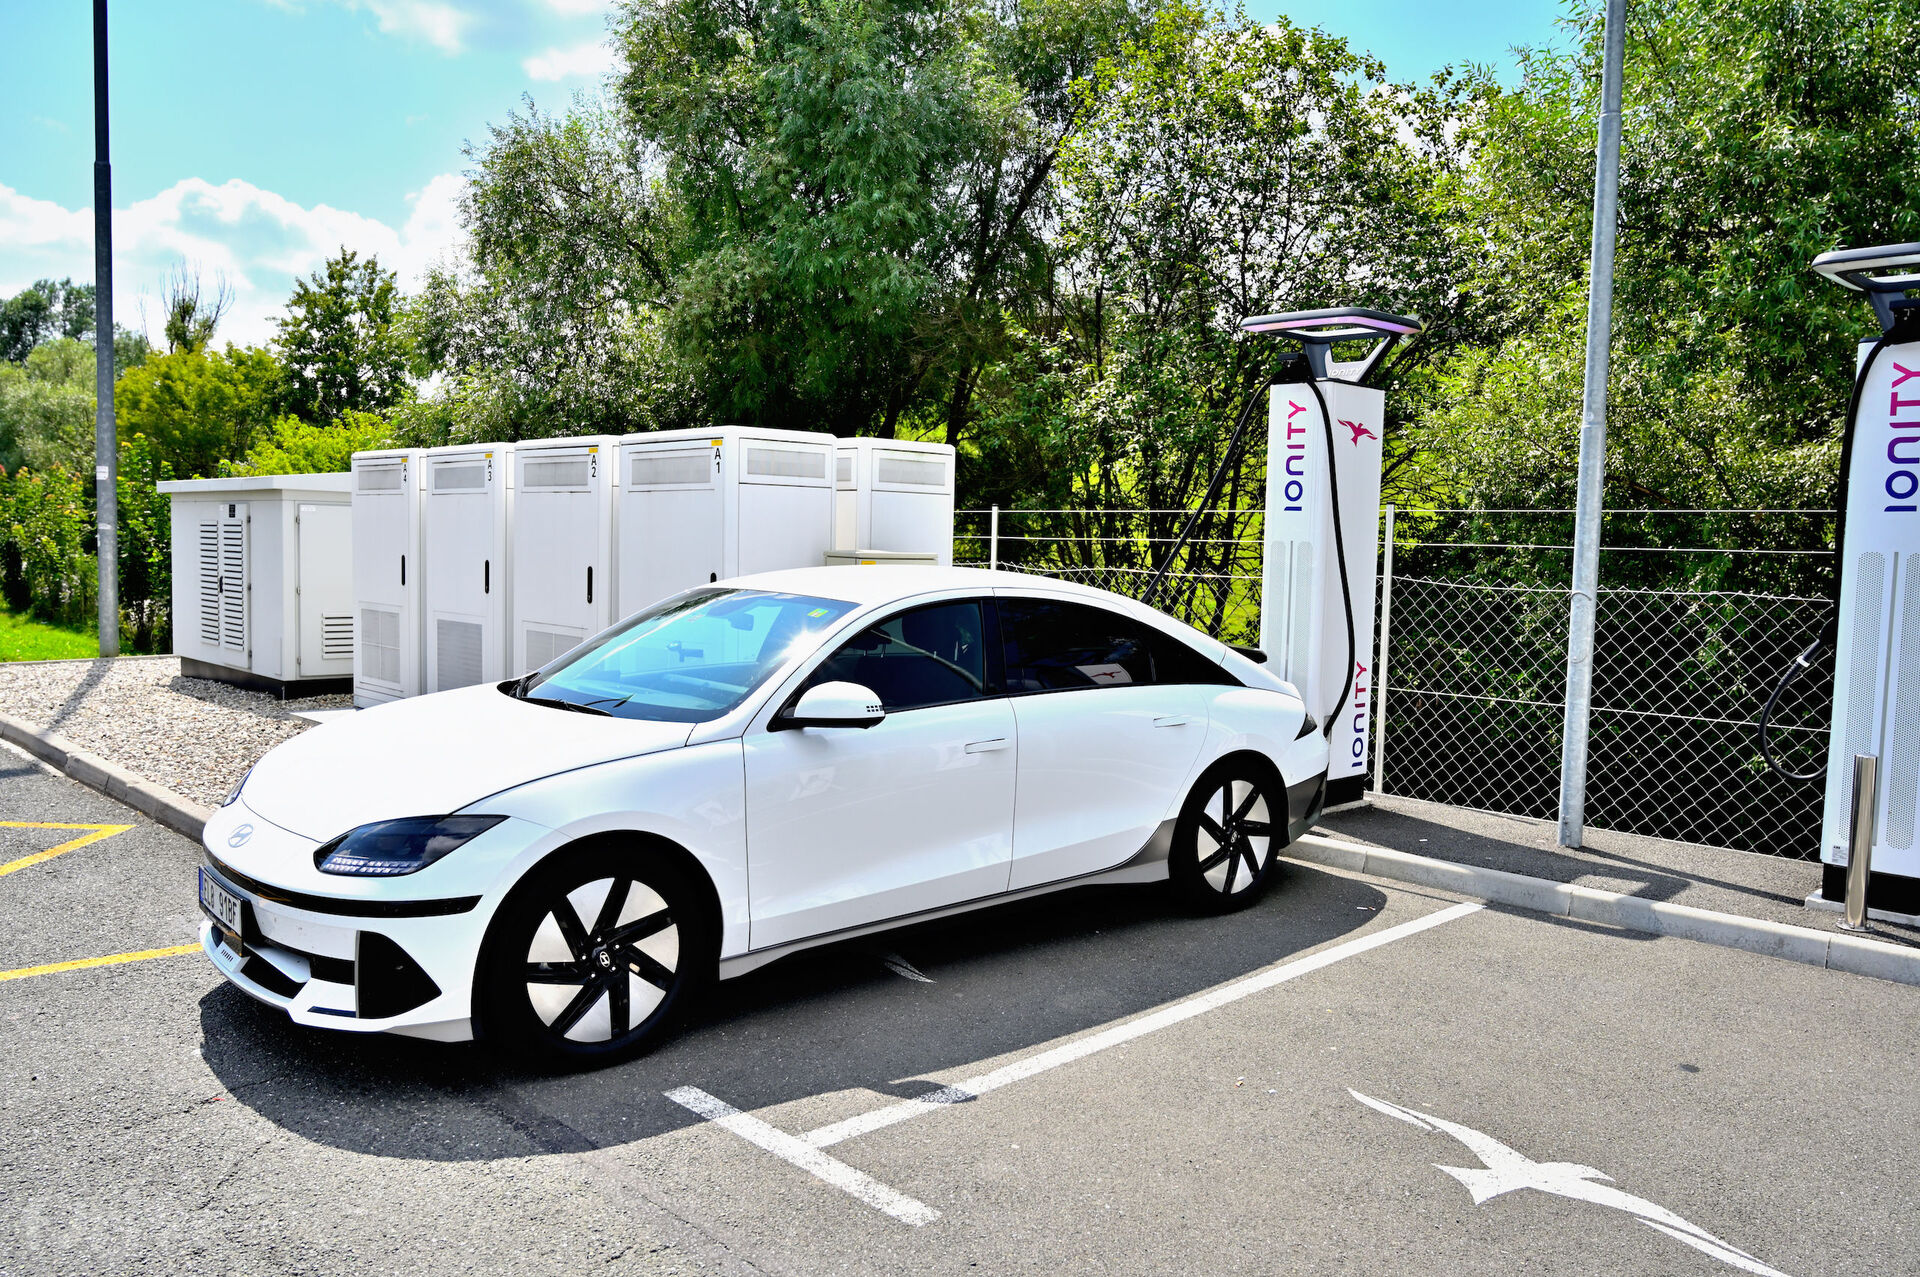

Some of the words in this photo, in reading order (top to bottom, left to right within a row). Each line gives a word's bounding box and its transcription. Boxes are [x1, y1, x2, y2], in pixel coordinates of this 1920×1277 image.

[1284, 400, 1307, 511] IONITY
[1884, 361, 1920, 512] IONITY
[1352, 661, 1367, 767] IONITY
